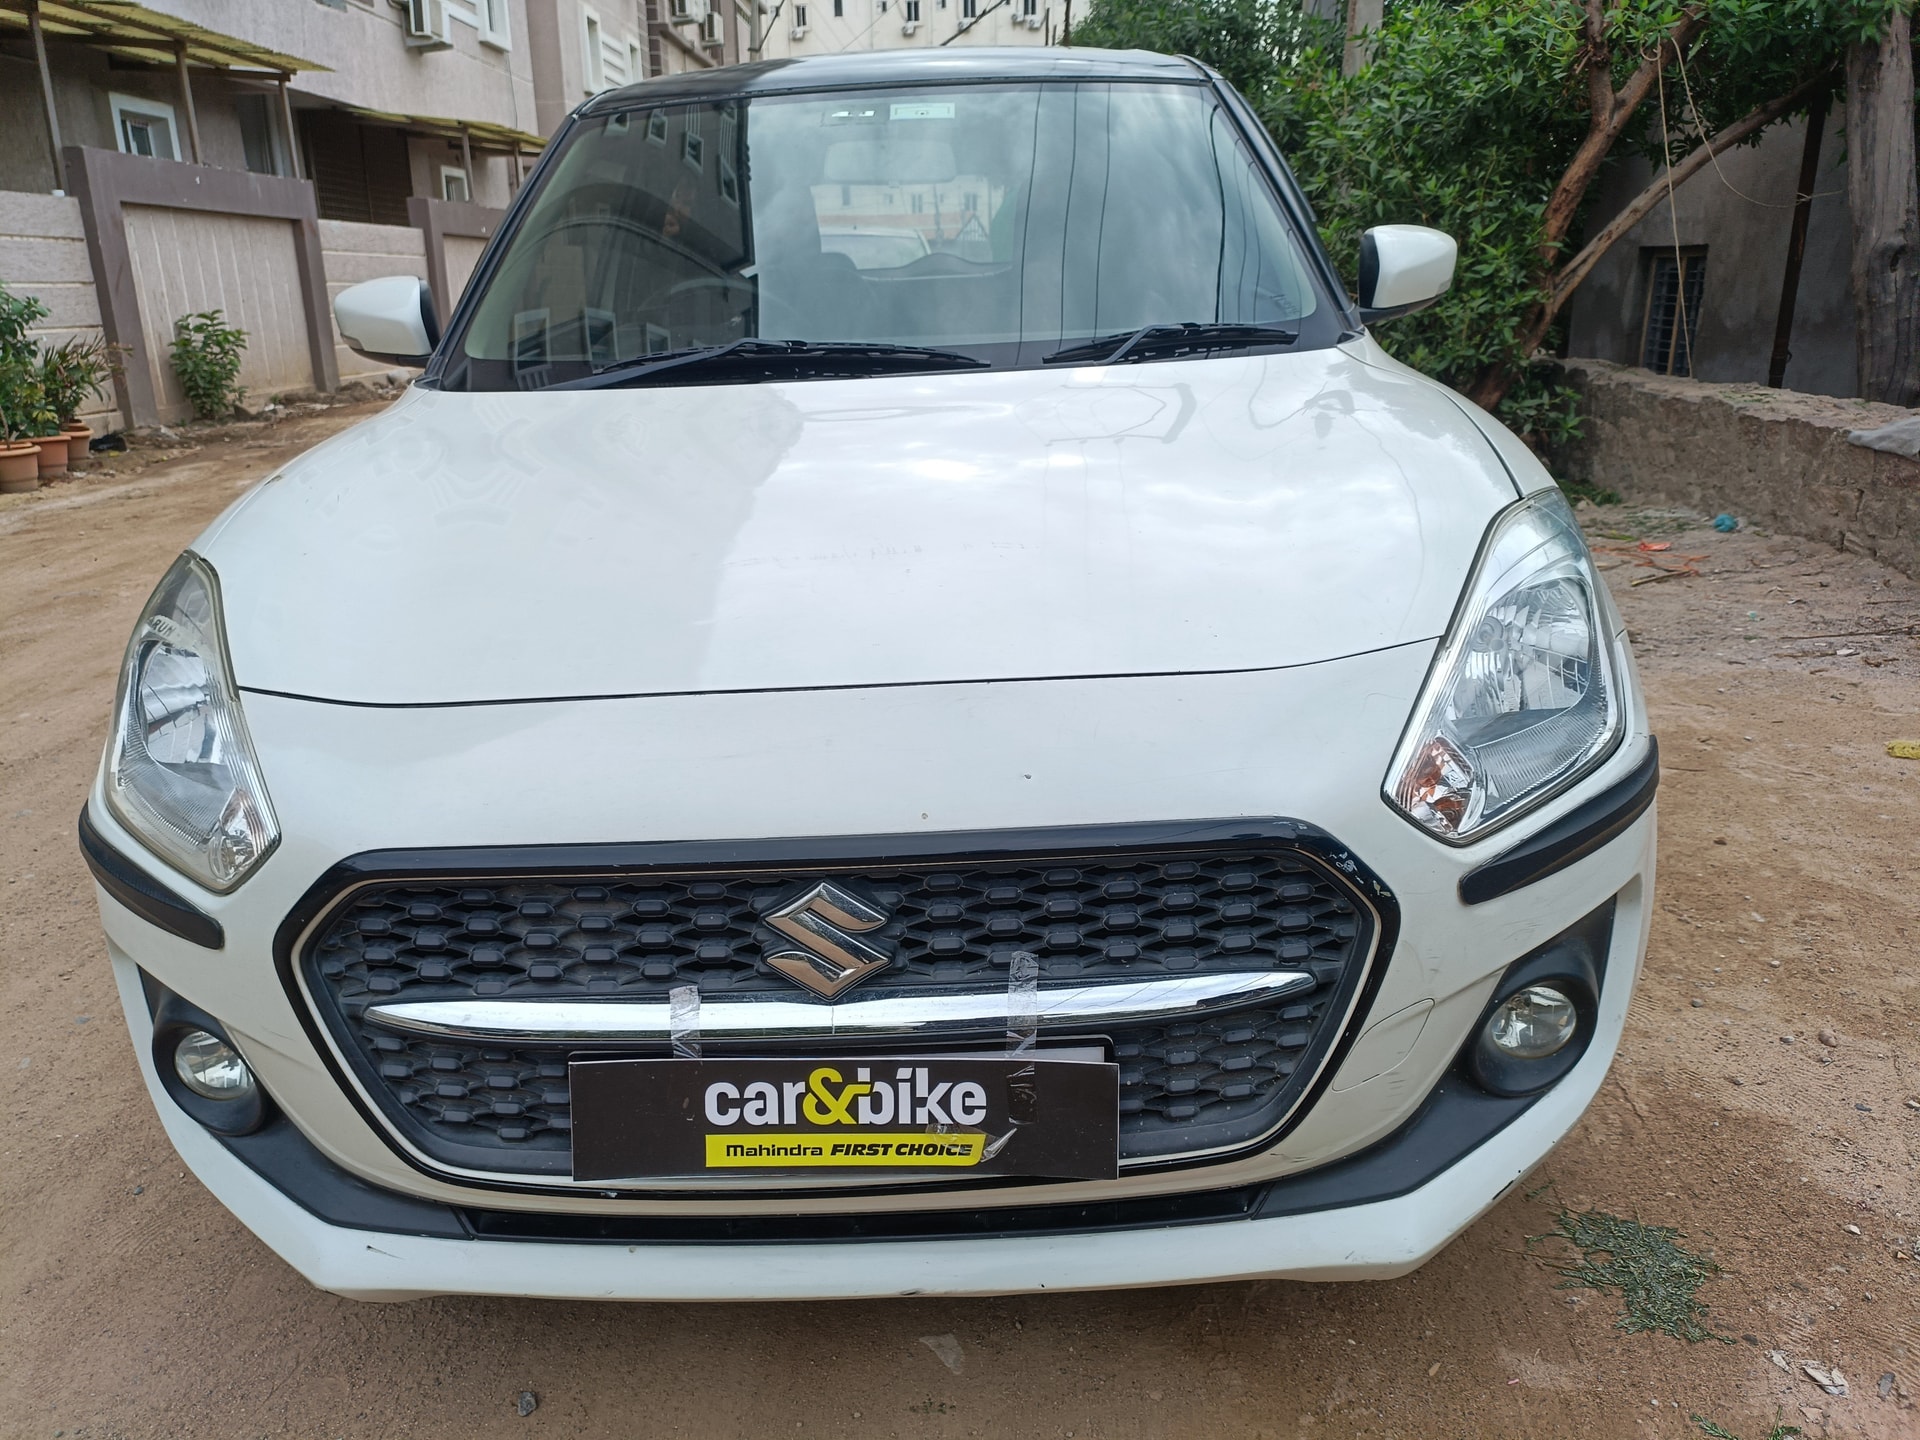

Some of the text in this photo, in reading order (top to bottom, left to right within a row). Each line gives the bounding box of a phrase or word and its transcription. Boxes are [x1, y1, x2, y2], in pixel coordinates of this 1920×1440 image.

[704, 1067, 987, 1126] car&bike
[725, 1142, 974, 1158] Mahindra FIRST CHOICE
